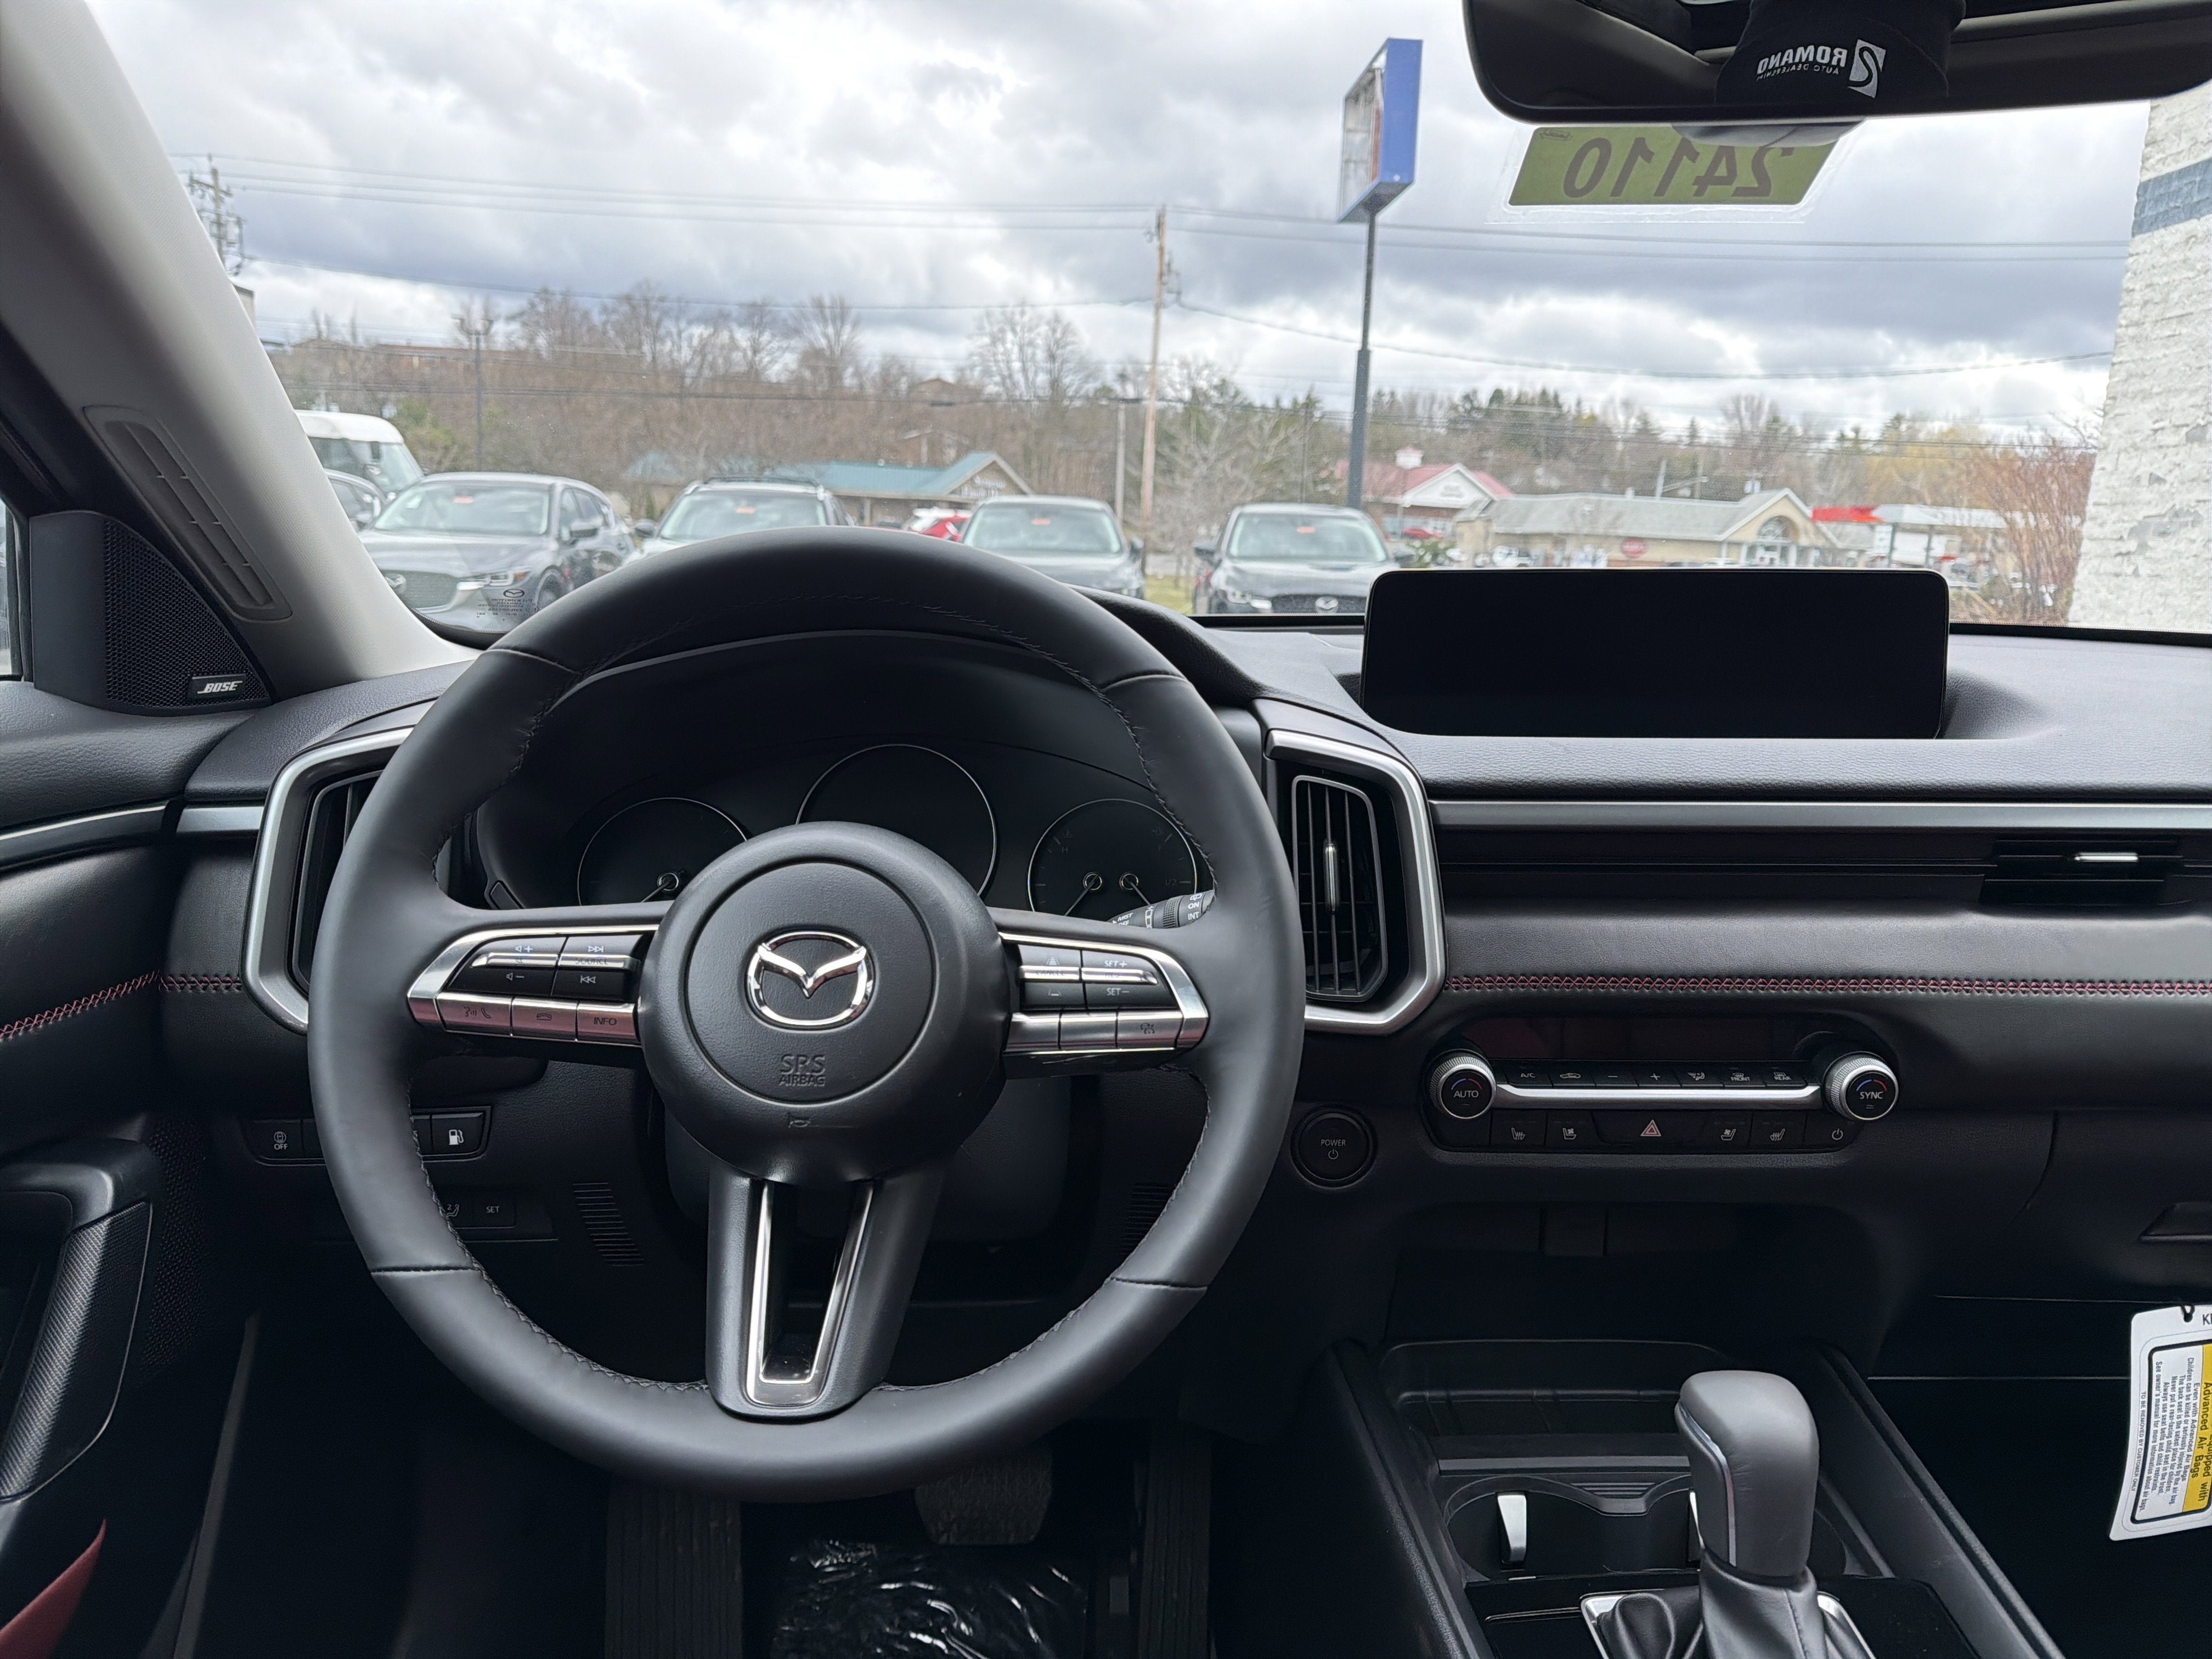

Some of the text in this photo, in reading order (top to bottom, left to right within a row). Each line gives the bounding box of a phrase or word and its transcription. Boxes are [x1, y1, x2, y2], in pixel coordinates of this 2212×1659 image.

[198, 681, 242, 694] BOSE
[1188, 912, 1200, 920] INT
[593, 1017, 617, 1026] INFO
[780, 1053, 826, 1075] SRS
[778, 1074, 826, 1087] AIRBAG
[1859, 1091, 1884, 1100] SYNC
[2162, 1382, 2170, 1401] Always
[2179, 1426, 2188, 1450] seriously
[2187, 1419, 2197, 1452] Advanced
[2191, 1382, 2212, 1478] Advanced Air Bags
[2148, 1445, 2158, 1475] information
[2177, 1452, 2186, 1469] injured
[2181, 1465, 2190, 1481] Bags
[2198, 1482, 2208, 1501] with
